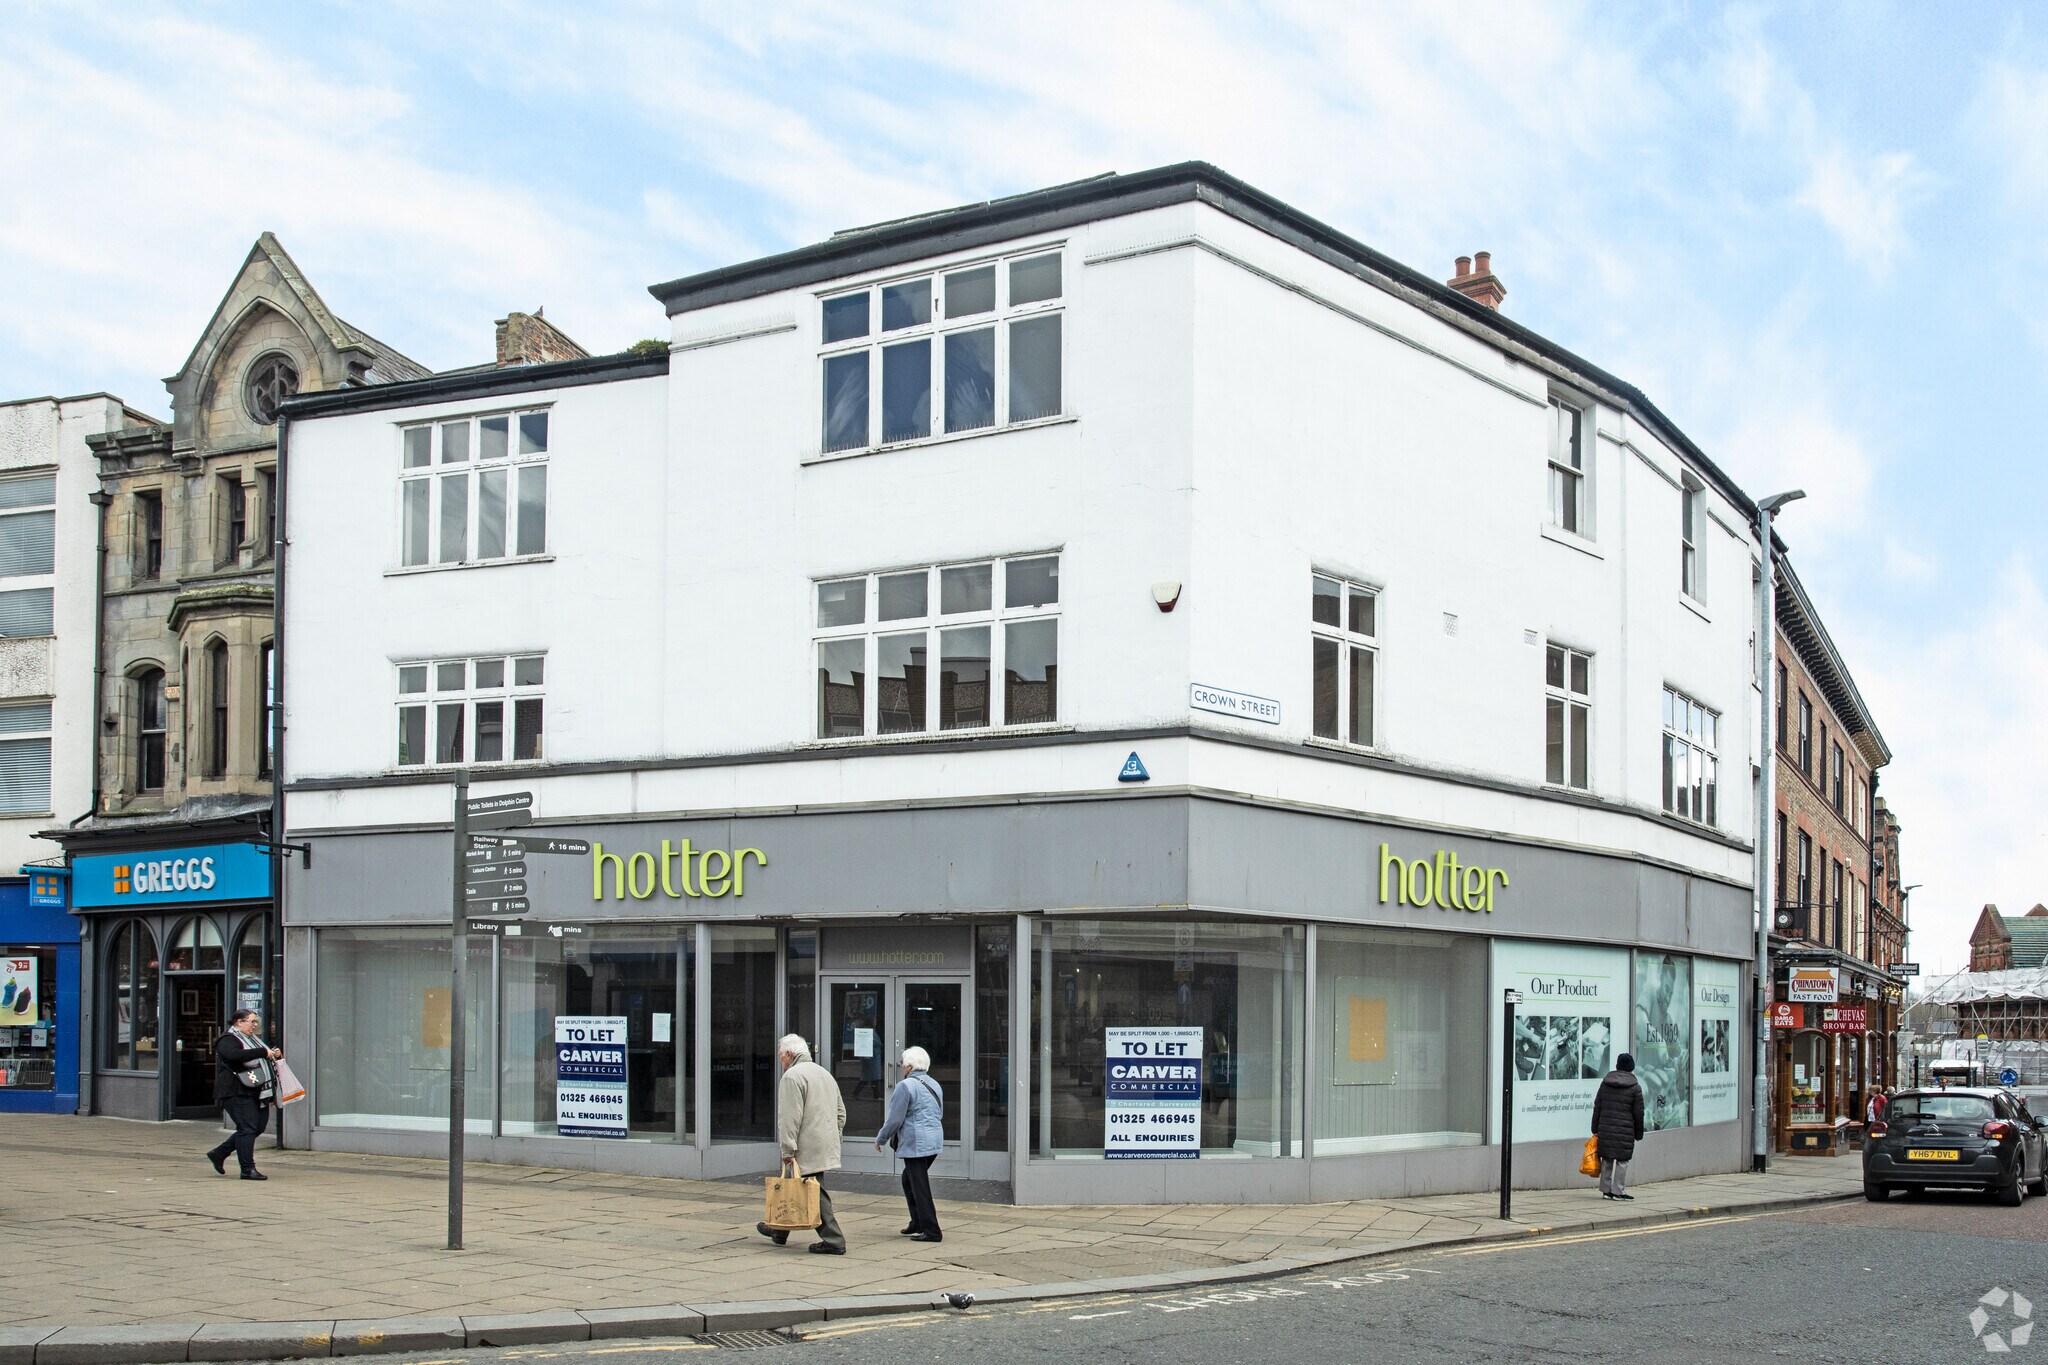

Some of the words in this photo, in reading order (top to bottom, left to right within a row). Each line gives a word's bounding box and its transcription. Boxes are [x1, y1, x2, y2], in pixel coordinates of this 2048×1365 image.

[1194, 690, 1236, 709] CROWN
[1241, 700, 1277, 717] STREET
[467, 803, 480, 811] Public
[481, 801, 494, 809] Toilets
[499, 799, 515, 808] Dolphin
[133, 857, 216, 894] GREGGS
[593, 838, 768, 900] hotter
[1380, 842, 1510, 912] hotter
[472, 923, 499, 931] Library
[848, 950, 944, 964] www.hotter.com
[1890, 963, 1918, 971] Traditional
[1531, 977, 1555, 994] Our
[1557, 978, 1598, 996] Product
[1791, 979, 1835, 994] CHINATOWN
[1701, 987, 1712, 1002] Our
[1713, 988, 1730, 1006] Design
[566, 1029, 586, 1041] TO
[590, 1029, 615, 1042] LET
[1646, 1023, 1679, 1043] Est.1959
[1121, 1042, 1148, 1055] TO
[1154, 1042, 1188, 1056] LET
[559, 1049, 623, 1063] CARVER
[559, 1065, 623, 1073] COMMERCIAL
[1111, 1065, 1197, 1079] CARVER
[560, 1093, 586, 1102] 01325
[589, 1094, 623, 1104] 466945
[1548, 1104, 1561, 1113] perfect
[561, 1111, 575, 1119] ALL
[578, 1112, 623, 1121] ENQUIRIES
[1110, 1114, 1145, 1123] 01325
[1150, 1114, 1195, 1123] 466945
[559, 1128, 626, 1136] www.carvercommercial.co.uk
[1110, 1134, 1131, 1142] ALL
[1135, 1134, 1195, 1142] ENQUIRIES
[1913, 1150, 1935, 1158] YH67
[1936, 1151, 1954, 1159] DVL
